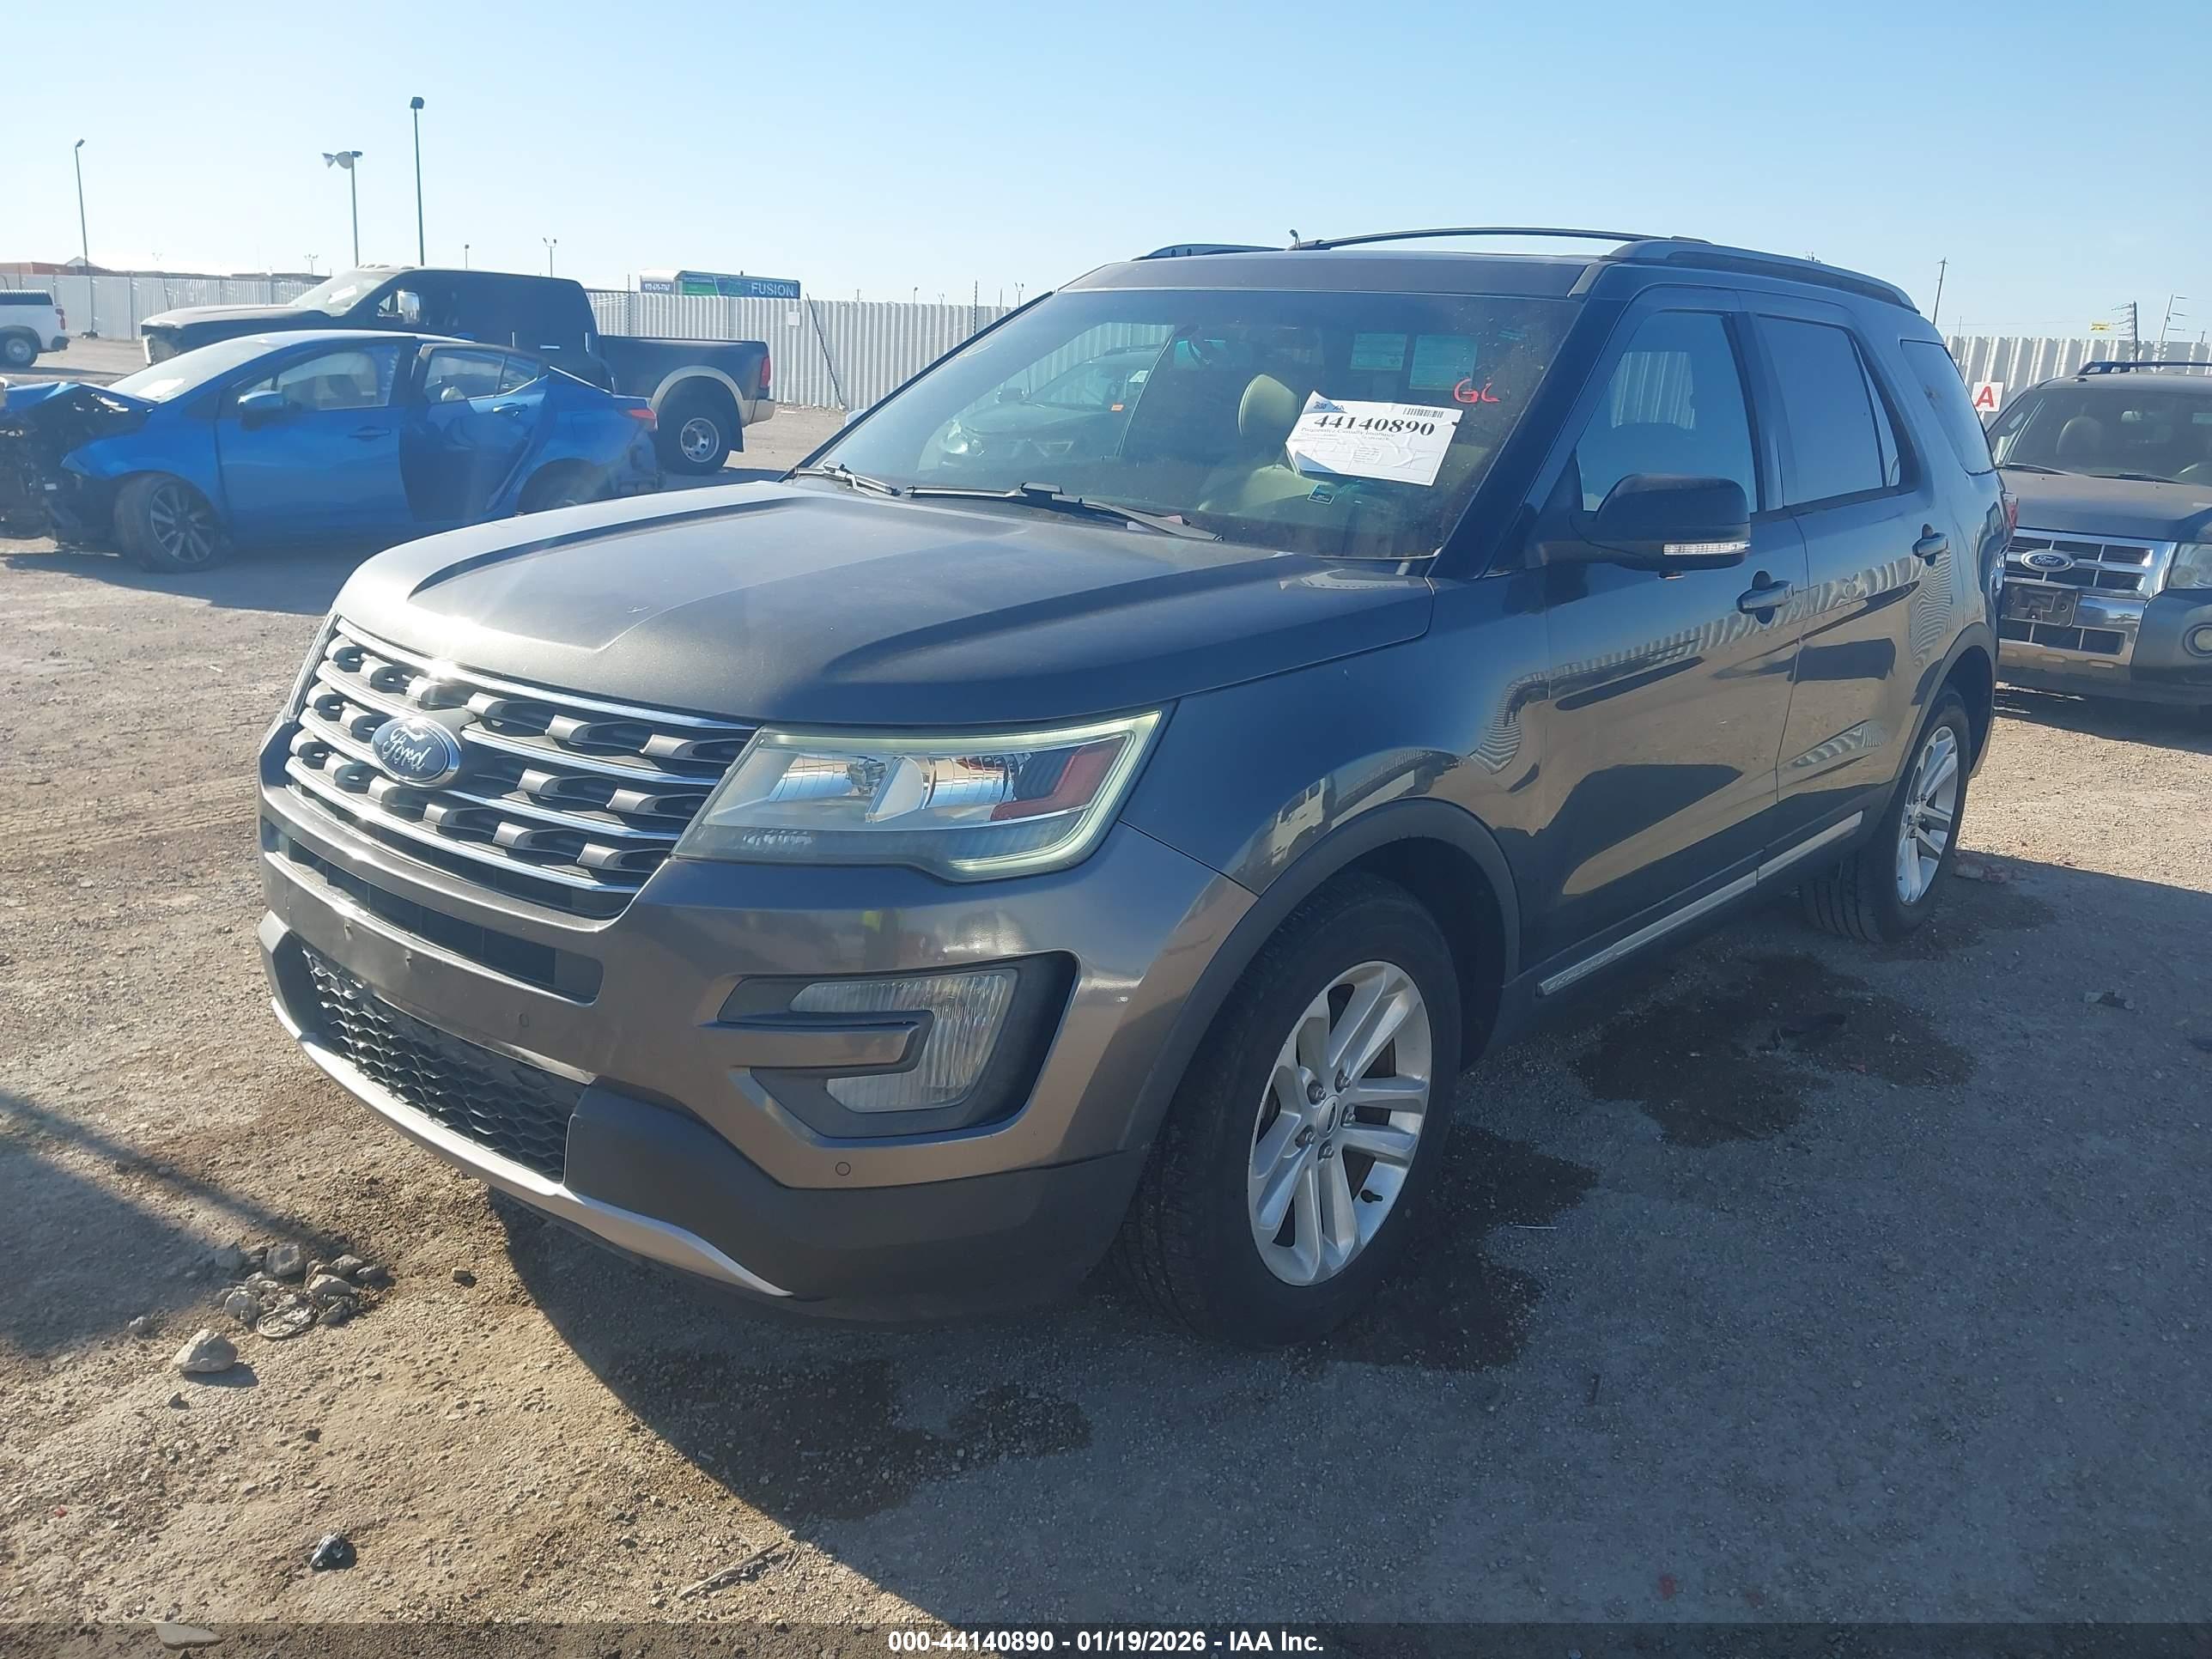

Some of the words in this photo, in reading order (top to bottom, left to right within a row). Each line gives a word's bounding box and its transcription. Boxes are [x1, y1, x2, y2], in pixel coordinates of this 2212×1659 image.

[751, 283, 794, 297] FUSION
[1975, 386, 1995, 407] A
[1314, 415, 1435, 436] 44140890
[2034, 555, 2060, 565] Ford
[382, 724, 431, 771] Ford
